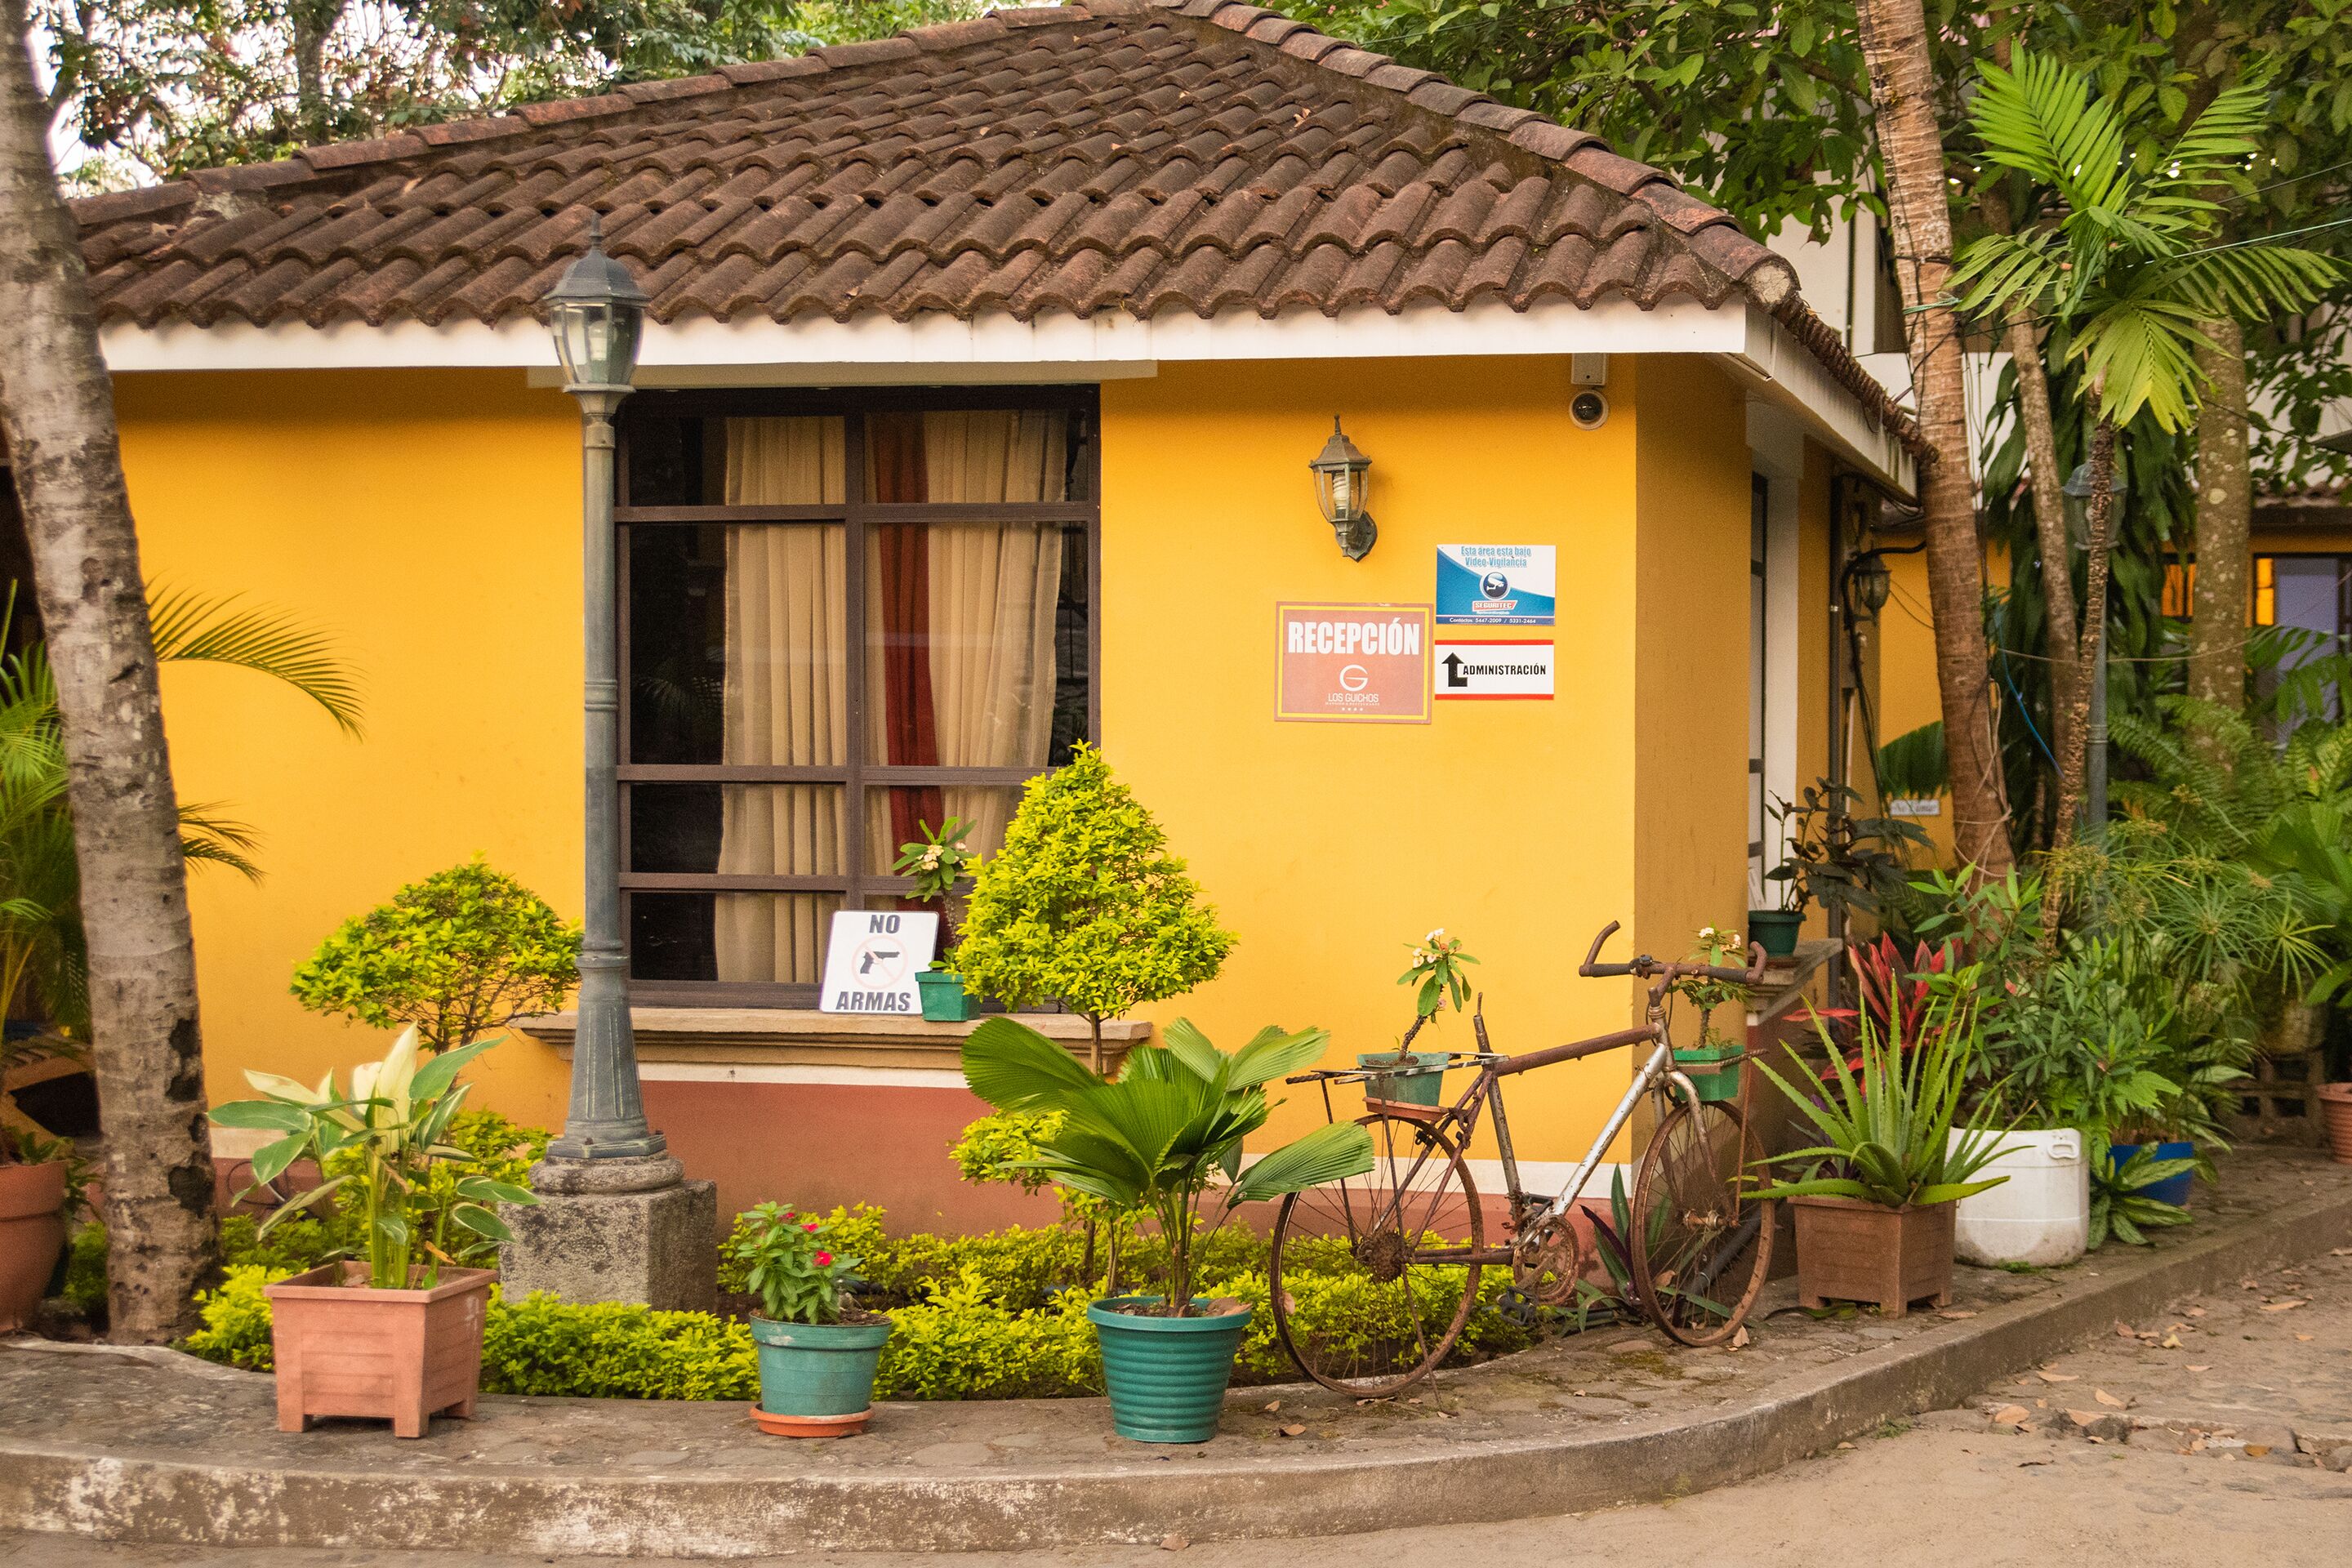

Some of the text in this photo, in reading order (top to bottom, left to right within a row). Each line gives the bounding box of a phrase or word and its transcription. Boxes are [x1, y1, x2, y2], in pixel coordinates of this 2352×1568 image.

[1461, 546, 1477, 556] Esta
[1514, 546, 1531, 558] bajo
[1465, 557, 1527, 568] Video-Vigilancia
[1288, 617, 1420, 656] RECEPCIÓN
[1463, 662, 1546, 675] ADMINISTRACIÓN
[1328, 693, 1379, 703] LOS GUICHOS
[869, 914, 901, 934] NO
[835, 991, 911, 1012] ARMAS
